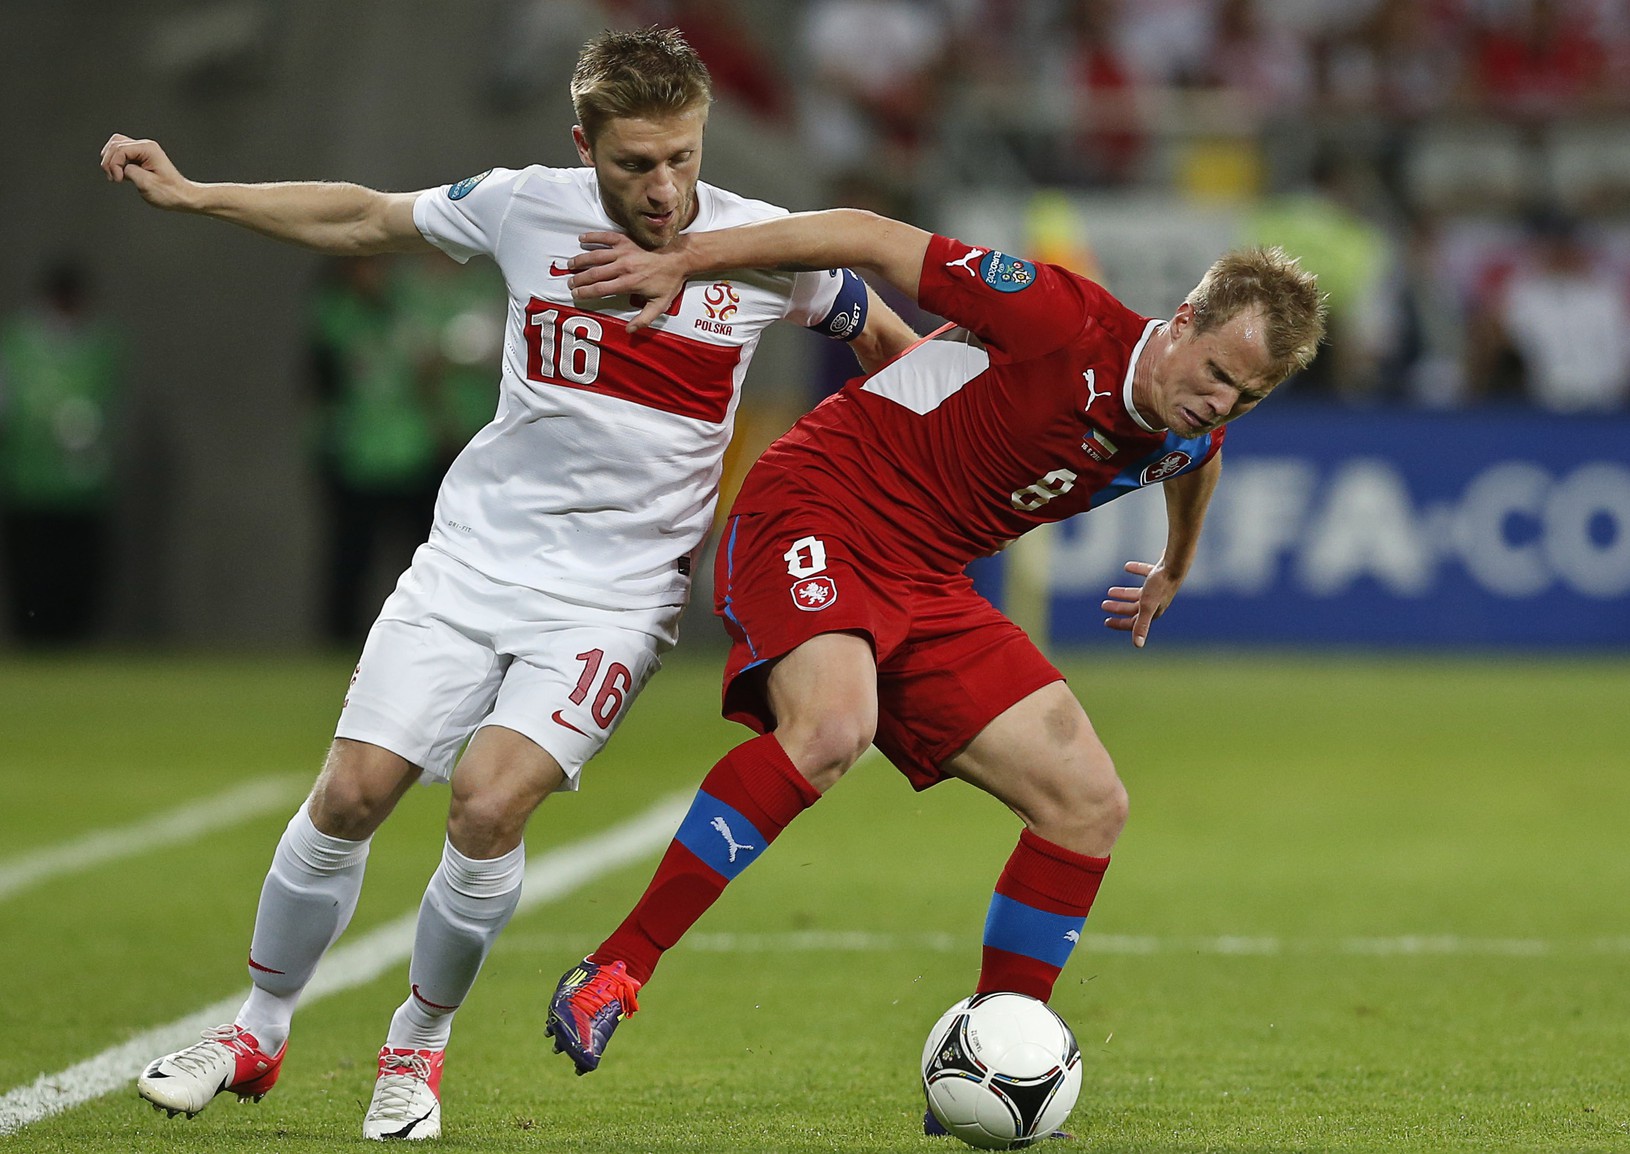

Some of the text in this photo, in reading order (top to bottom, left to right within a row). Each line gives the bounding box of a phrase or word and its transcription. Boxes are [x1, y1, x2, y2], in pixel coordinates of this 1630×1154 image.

[530, 308, 604, 385] 16
[694, 318, 733, 336] POLSKA
[1011, 468, 1077, 511] 8
[568, 648, 632, 729] 16
